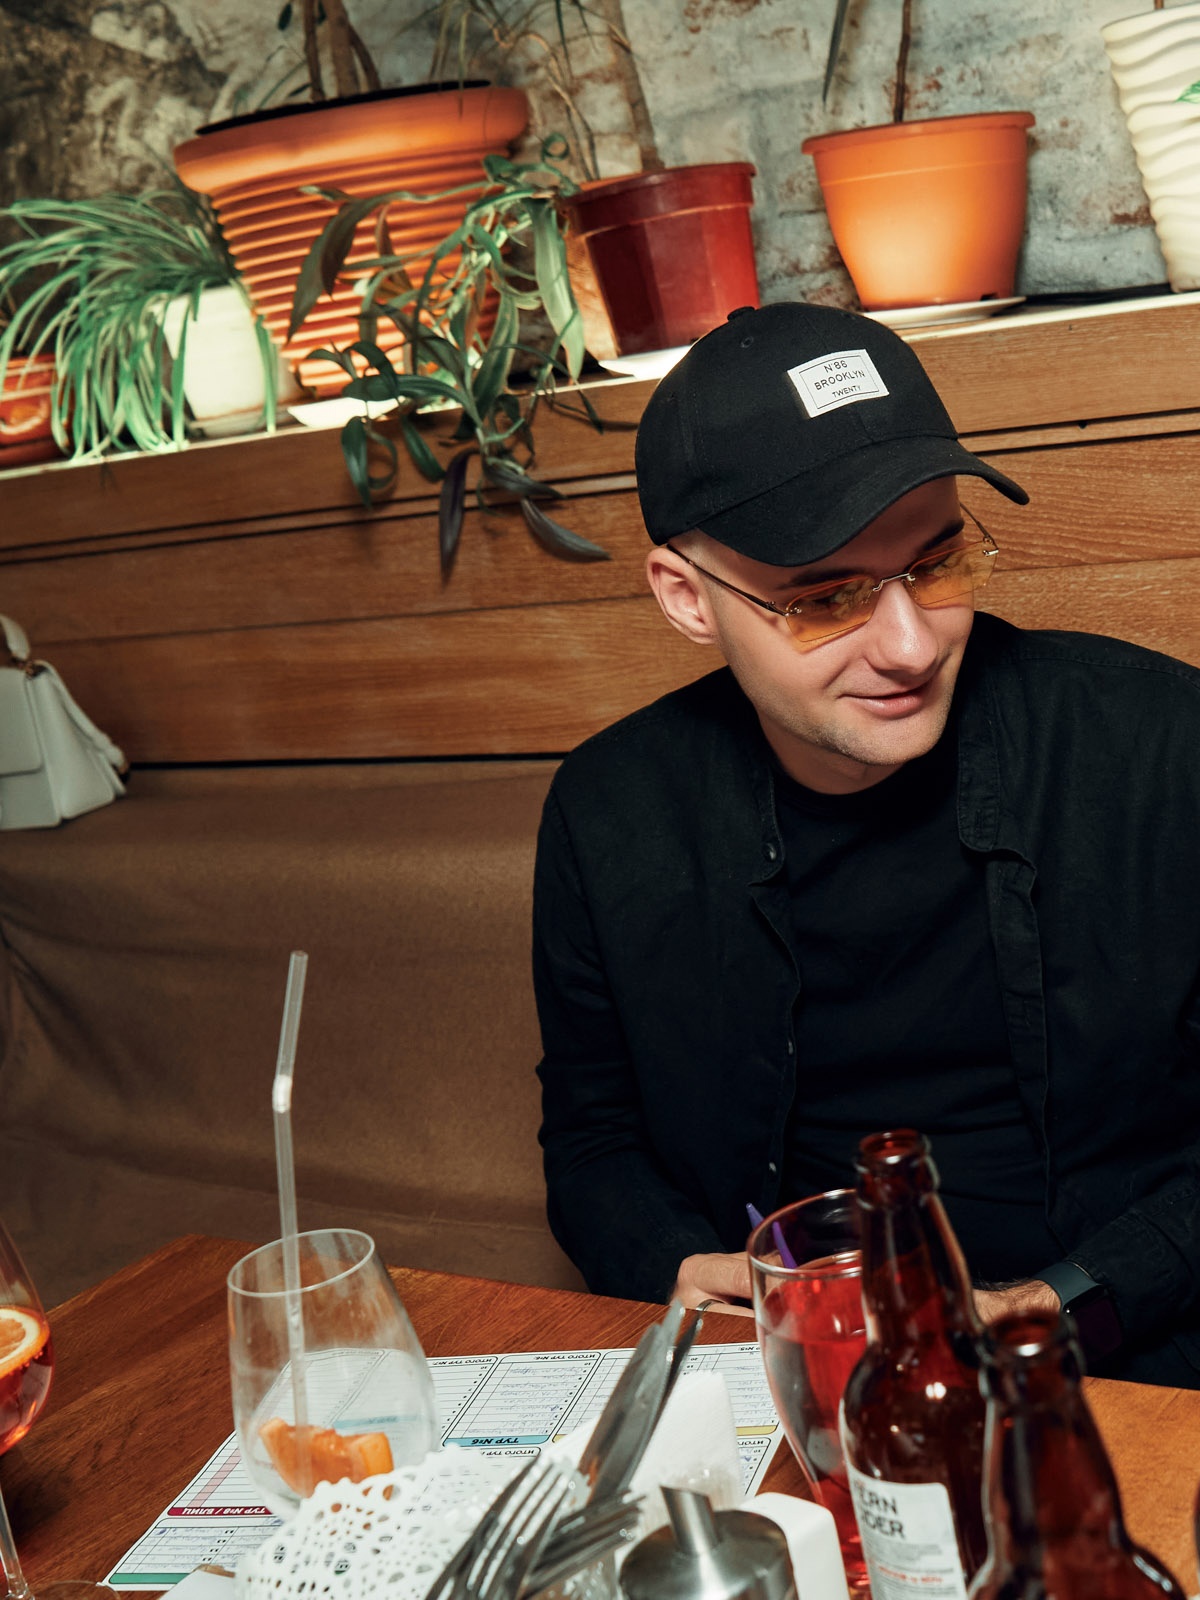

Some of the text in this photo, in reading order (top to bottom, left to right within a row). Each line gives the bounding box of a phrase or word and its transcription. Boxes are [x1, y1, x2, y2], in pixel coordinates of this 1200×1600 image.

[814, 369, 866, 391] BROOKLYN
[495, 1437, 519, 1445] ТУР
[181, 1507, 215, 1515] БЛИЦ
